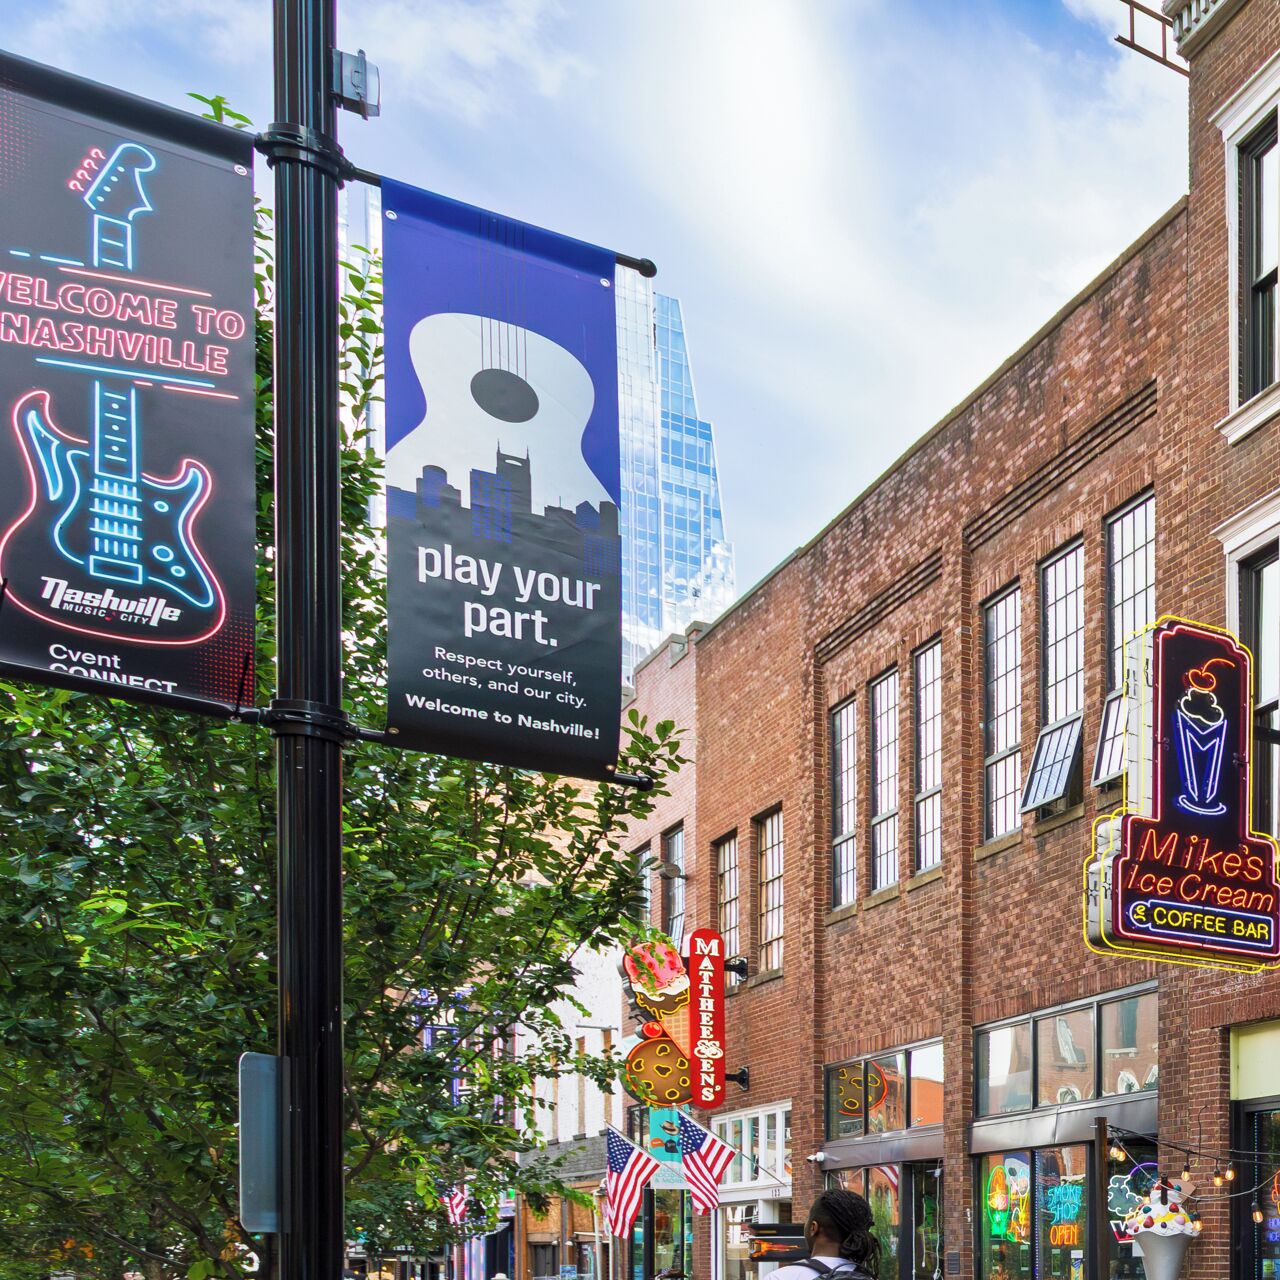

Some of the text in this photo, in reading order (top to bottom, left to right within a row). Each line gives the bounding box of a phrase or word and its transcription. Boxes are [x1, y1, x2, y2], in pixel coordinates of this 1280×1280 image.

[192, 304, 245, 340] TO
[0, 312, 229, 375] NASHVILLE
[418, 544, 601, 610] play your
[41, 576, 182, 627] Nashville
[63, 602, 150, 625] MUSIC CITY
[464, 601, 558, 647] part.
[49, 643, 121, 670] Cvent
[434, 646, 577, 687] Respect yourself,
[422, 667, 587, 709] others, and our city.
[405, 693, 600, 740] Welcome to Nashville!
[1140, 829, 1263, 881] Mike's
[1128, 865, 1274, 933] Ice Cream
[1153, 907, 1226, 934] COFFEE
[1233, 919, 1269, 941] BAR
[1048, 1184, 1083, 1207] SMOKE
[1050, 1203, 1080, 1224] SHOP
[1050, 1224, 1078, 1246] OPEN
